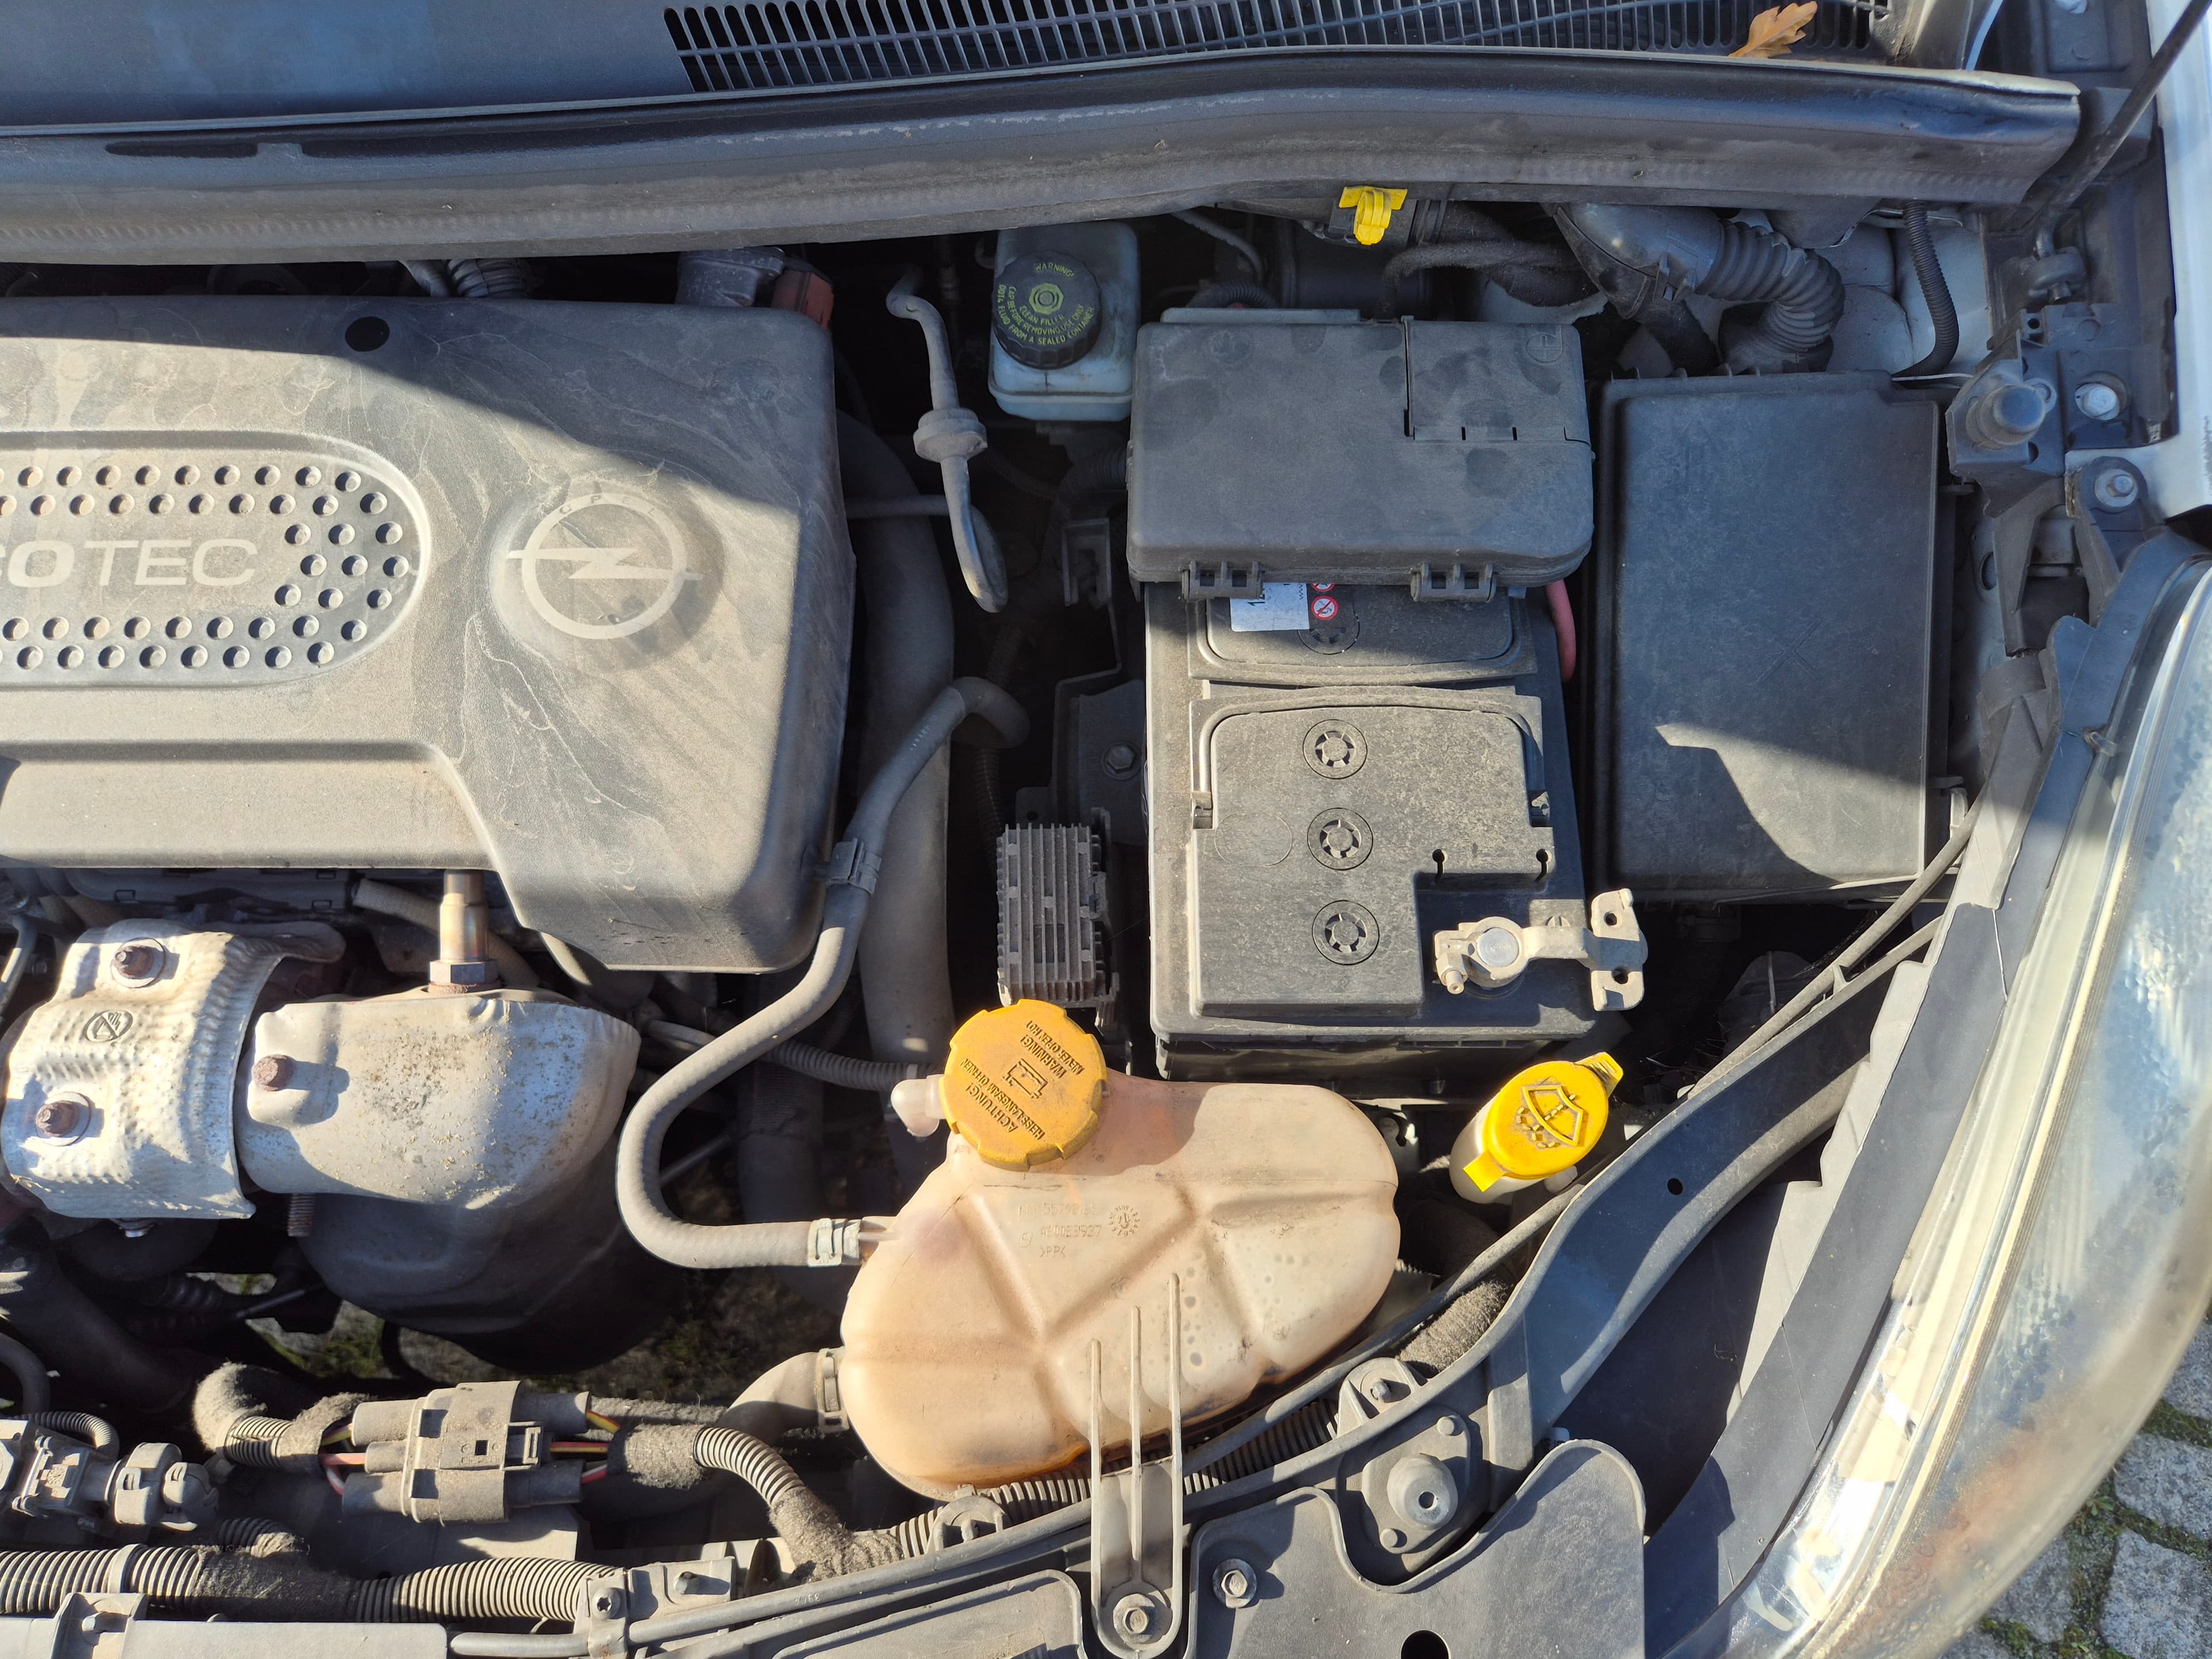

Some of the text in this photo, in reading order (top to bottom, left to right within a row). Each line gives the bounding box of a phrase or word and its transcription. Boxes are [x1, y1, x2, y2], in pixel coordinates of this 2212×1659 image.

[1034, 263, 1074, 277] WARNING!
[998, 306, 1010, 325] FLUID
[1009, 324, 1028, 340] FROM
[1037, 335, 1066, 345] SEALED
[1068, 306, 1094, 339] CONTAINER
[1007, 286, 1085, 335] CAP BEFORE REMOVING USE ONLY
[1019, 305, 1065, 325] CLEAN FILLER
[559, 494, 655, 517] OPEL
[0, 539, 258, 588] OTEC
[1020, 1034, 1067, 1079] WARNING!
[1025, 1020, 1085, 1075] NEVER OPEN HOT
[965, 1082, 1018, 1132] ACHTUNG!
